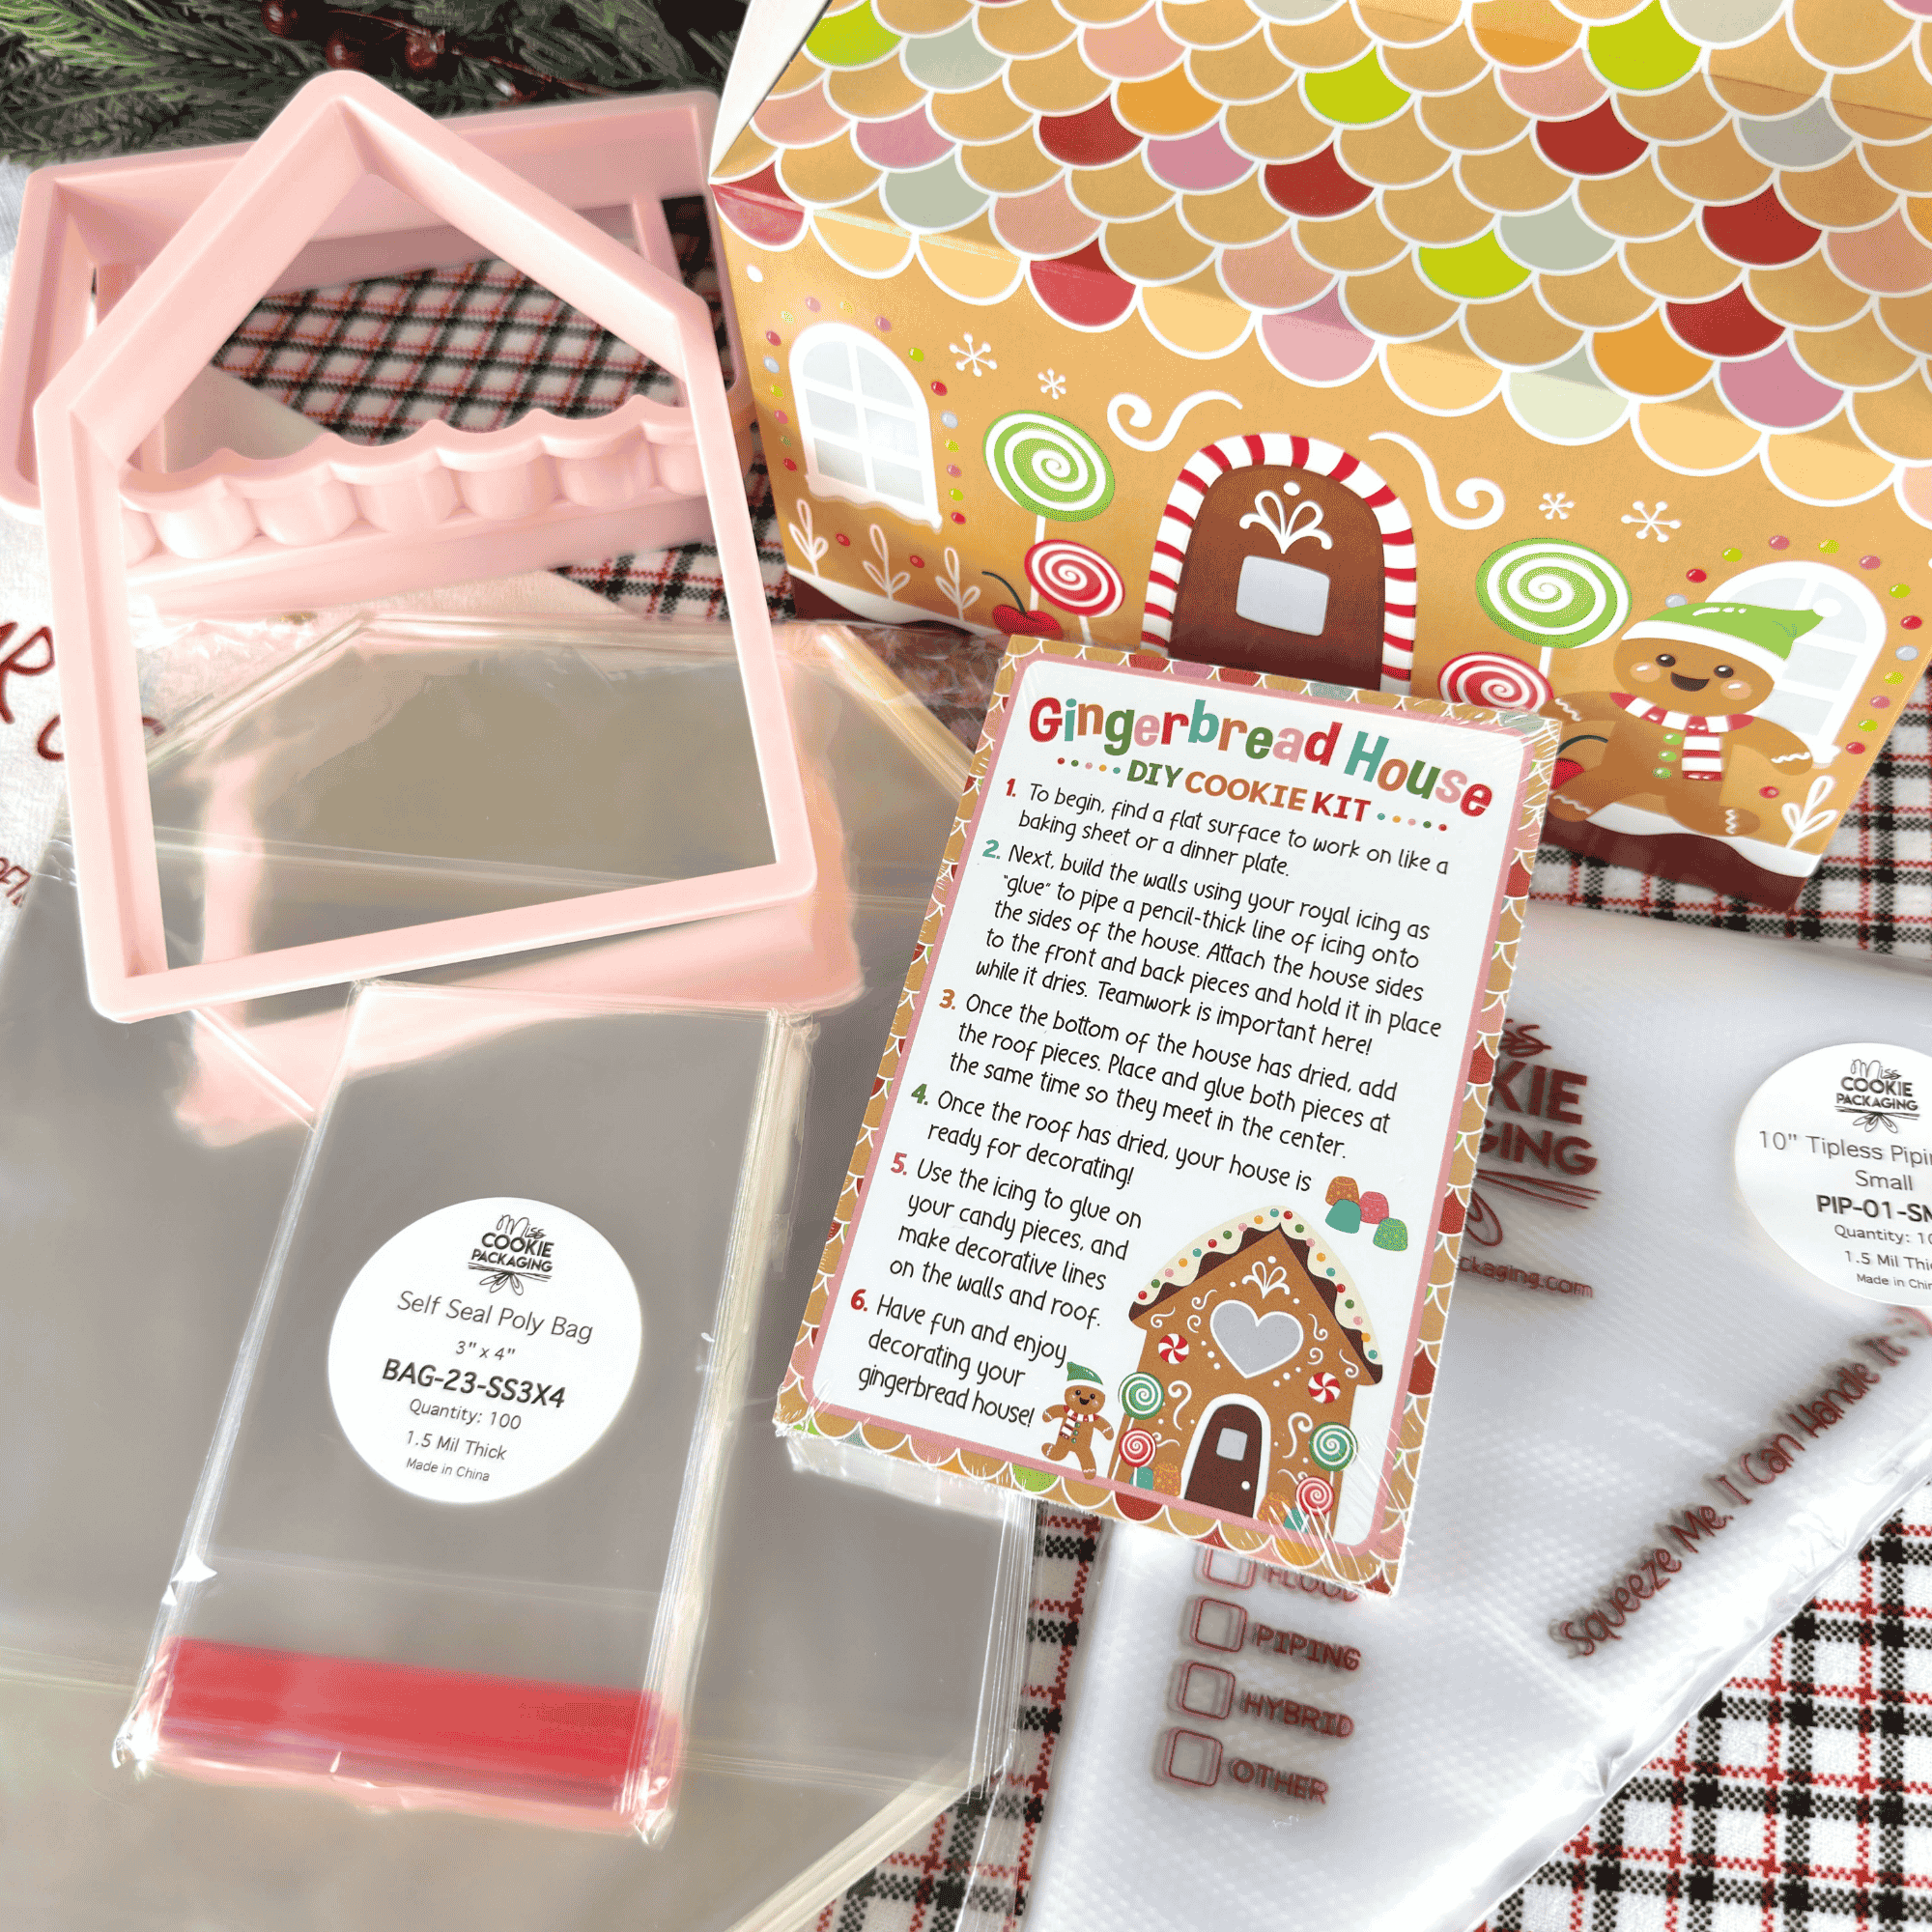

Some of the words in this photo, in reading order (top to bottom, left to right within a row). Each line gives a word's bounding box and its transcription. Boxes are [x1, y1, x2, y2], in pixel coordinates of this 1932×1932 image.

[1029, 697, 1343, 764] Gingerbread
[1344, 730, 1493, 818] House
[1125, 758, 1184, 788] DIY
[1184, 770, 1308, 809] COOKIE
[1310, 790, 1372, 823] KIT
[1005, 777, 1016, 798] 1.
[1030, 782, 1050, 803] To
[1053, 786, 1105, 815] begin,
[1110, 799, 1150, 820] find
[1151, 809, 1165, 824] a
[1169, 809, 1204, 831] flat
[1207, 818, 1281, 844] surface
[1288, 828, 1307, 848] to
[1312, 838, 1360, 859] work
[1366, 848, 1392, 865] on
[1397, 848, 1431, 871] like
[1435, 860, 1449, 875] a
[1017, 809, 1077, 842] baking
[1081, 821, 1131, 847] sheet
[1135, 836, 1159, 851] or
[1162, 839, 1175, 855] a
[1179, 838, 1239, 867] dinner
[1240, 851, 1289, 877] plate.
[981, 838, 1001, 860] 2.
[1008, 843, 1055, 869] Next,
[1059, 852, 1105, 878] build
[1109, 862, 1139, 885] the
[1142, 872, 1188, 894] walls
[1193, 881, 1242, 911] using
[1247, 892, 1295, 914] your
[1298, 901, 1350, 928] royal
[1355, 908, 1401, 941] icing
[1406, 923, 1430, 940] as
[1003, 873, 1051, 897] "glue"
[1056, 881, 1075, 902] to
[1078, 888, 1119, 914] pipe
[1122, 899, 1135, 915] a
[1138, 901, 1246, 935] pencil-thick
[1251, 919, 1286, 943] line
[1290, 931, 1317, 954] of
[1320, 932, 1365, 965] icing
[1371, 947, 1419, 969] onto
[994, 899, 1023, 923] the
[1027, 907, 1072, 932] sides
[1076, 921, 1101, 943] of
[1106, 921, 1137, 945] the
[1140, 926, 1200, 958] house.
[1206, 941, 1265, 970] Attach
[1272, 953, 1304, 978] the
[1308, 960, 1370, 991] house
[1375, 976, 1424, 1002] sides
[975, 957, 1019, 982] while
[1022, 965, 1038, 986] it
[1040, 970, 1088, 998] dries.
[1097, 980, 1192, 1017] Teamwork
[1195, 1001, 1212, 1022] is
[1215, 1005, 1317, 1044] important
[1321, 1026, 1373, 1056] here!
[938, 988, 955, 1010] 3.
[965, 992, 1013, 1019] Once
[1018, 1003, 1049, 1027] the
[1051, 1009, 1120, 1041] bottom
[1124, 1031, 1151, 1054] of
[1156, 1032, 1187, 1057] the
[1191, 1038, 1252, 1070] house
[1256, 1052, 1293, 1079] has
[1297, 1063, 1351, 1094] dried,
[1358, 1078, 1398, 1102] add
[1850, 1059, 1902, 1080] Miss
[1835, 1093, 1918, 1112] PACKAGING
[1840, 1076, 1914, 1097] COOKIE
[910, 1082, 928, 1106] 4.
[937, 1090, 985, 1118] Once
[991, 1100, 1022, 1125] the
[1025, 1112, 1073, 1143] roof
[1075, 1119, 1112, 1146] has
[1116, 1129, 1169, 1160] dried,
[1175, 1146, 1225, 1172] your
[1228, 1153, 1291, 1187] house
[1294, 1169, 1312, 1192] is
[926, 1123, 982, 1156] ready
[985, 1137, 1022, 1159] for
[1025, 1142, 1135, 1190] decorating!
[1759, 1130, 1798, 1151] 10"
[1805, 1135, 1884, 1160] Tipless
[890, 1151, 907, 1176] 5.
[917, 1157, 952, 1184] Use
[958, 1167, 989, 1193] the
[992, 1176, 1037, 1211] icing
[1043, 1186, 1064, 1210] to
[1068, 1195, 1111, 1222] glue
[1115, 1209, 1142, 1229] on
[1854, 1169, 1914, 1191] Small
[481, 1232, 555, 1258] COOKIE
[496, 1214, 547, 1239] Miss
[907, 1194, 955, 1219] your
[958, 1207, 1016, 1240] candy
[1019, 1218, 1084, 1251] pieces,
[1090, 1238, 1130, 1261] and
[1833, 1224, 1911, 1245] Quantity:
[470, 1248, 554, 1272] PACKAGING
[896, 1225, 951, 1252] make
[954, 1235, 1058, 1278] decorative
[1061, 1260, 1107, 1291] lines
[1844, 1250, 1871, 1265] 1.5
[1877, 1253, 1899, 1268] Mil
[1856, 1272, 1889, 1286] Made
[1892, 1276, 1905, 1288] in
[397, 1291, 442, 1316] Self
[446, 1298, 494, 1324] Seal
[497, 1307, 546, 1336] Poly
[551, 1316, 593, 1345] Bag
[889, 1259, 915, 1278] on
[922, 1261, 952, 1288] the
[955, 1274, 1005, 1300] walls
[1009, 1289, 1048, 1312] and
[1049, 1297, 1100, 1330] roof.
[455, 1340, 477, 1355] 3"
[479, 1347, 491, 1359] x
[494, 1348, 516, 1361] 4"
[849, 1288, 868, 1312] 6.
[875, 1293, 926, 1325] Have
[929, 1312, 965, 1335] fun
[970, 1323, 1009, 1347] and
[1013, 1333, 1067, 1369] enjoy
[382, 1357, 566, 1408] BAG-23-SS3X4
[867, 1328, 971, 1380] decorating
[976, 1360, 1026, 1387] your
[409, 1398, 483, 1426] Quantity:
[490, 1411, 523, 1430] 100
[858, 1363, 971, 1410] gingerbread
[971, 1389, 1036, 1428] house!
[406, 1430, 433, 1448] 1.5
[437, 1435, 461, 1453] Mil
[465, 1439, 508, 1461] Thick
[406, 1457, 439, 1473] Made
[441, 1463, 453, 1476] in
[456, 1466, 491, 1482] China
[1558, 1548, 1683, 1657] Squeeze
[1715, 1473, 1753, 1505] I
[1738, 1433, 1805, 1486] Can
[1788, 1362, 1882, 1439] Handle
[1255, 1623, 1361, 1672] PIPING
[1242, 1691, 1354, 1739] HYBRID
[1231, 1759, 1329, 1804] OTHER
